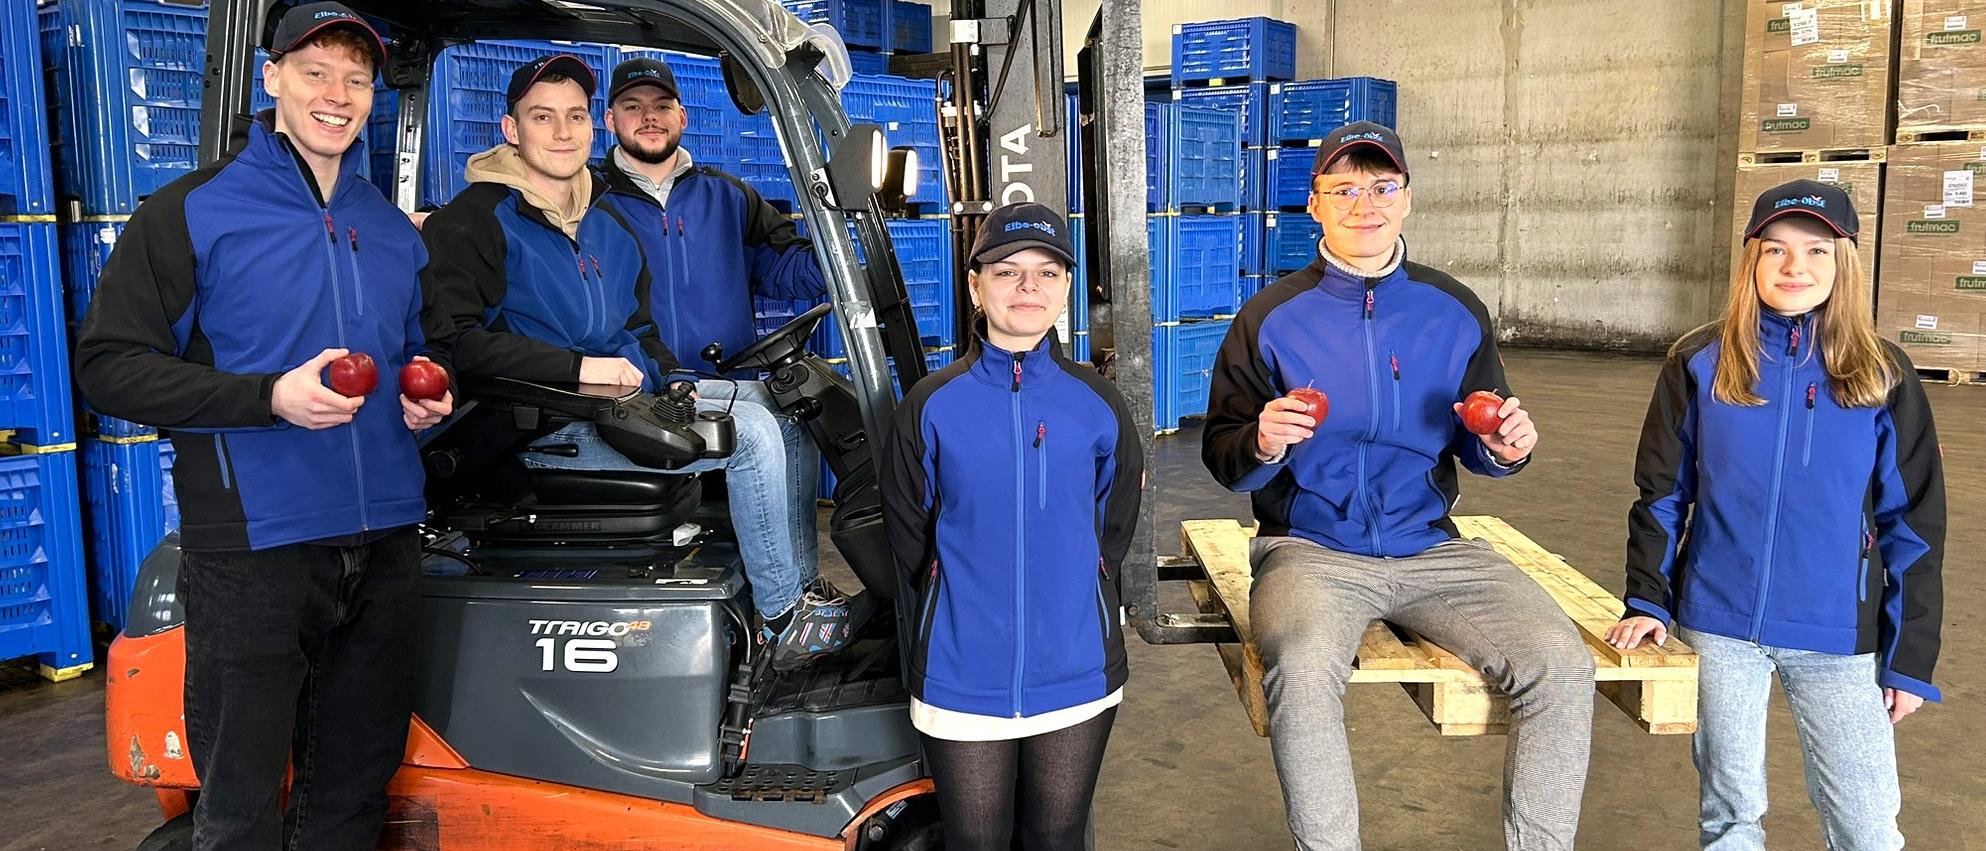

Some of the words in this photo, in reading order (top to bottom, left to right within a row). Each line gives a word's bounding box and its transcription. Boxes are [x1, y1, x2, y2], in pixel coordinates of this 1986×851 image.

[1910, 222, 1956, 232] frutmac
[529, 620, 630, 637] TRAIGO
[535, 637, 619, 673] 16
